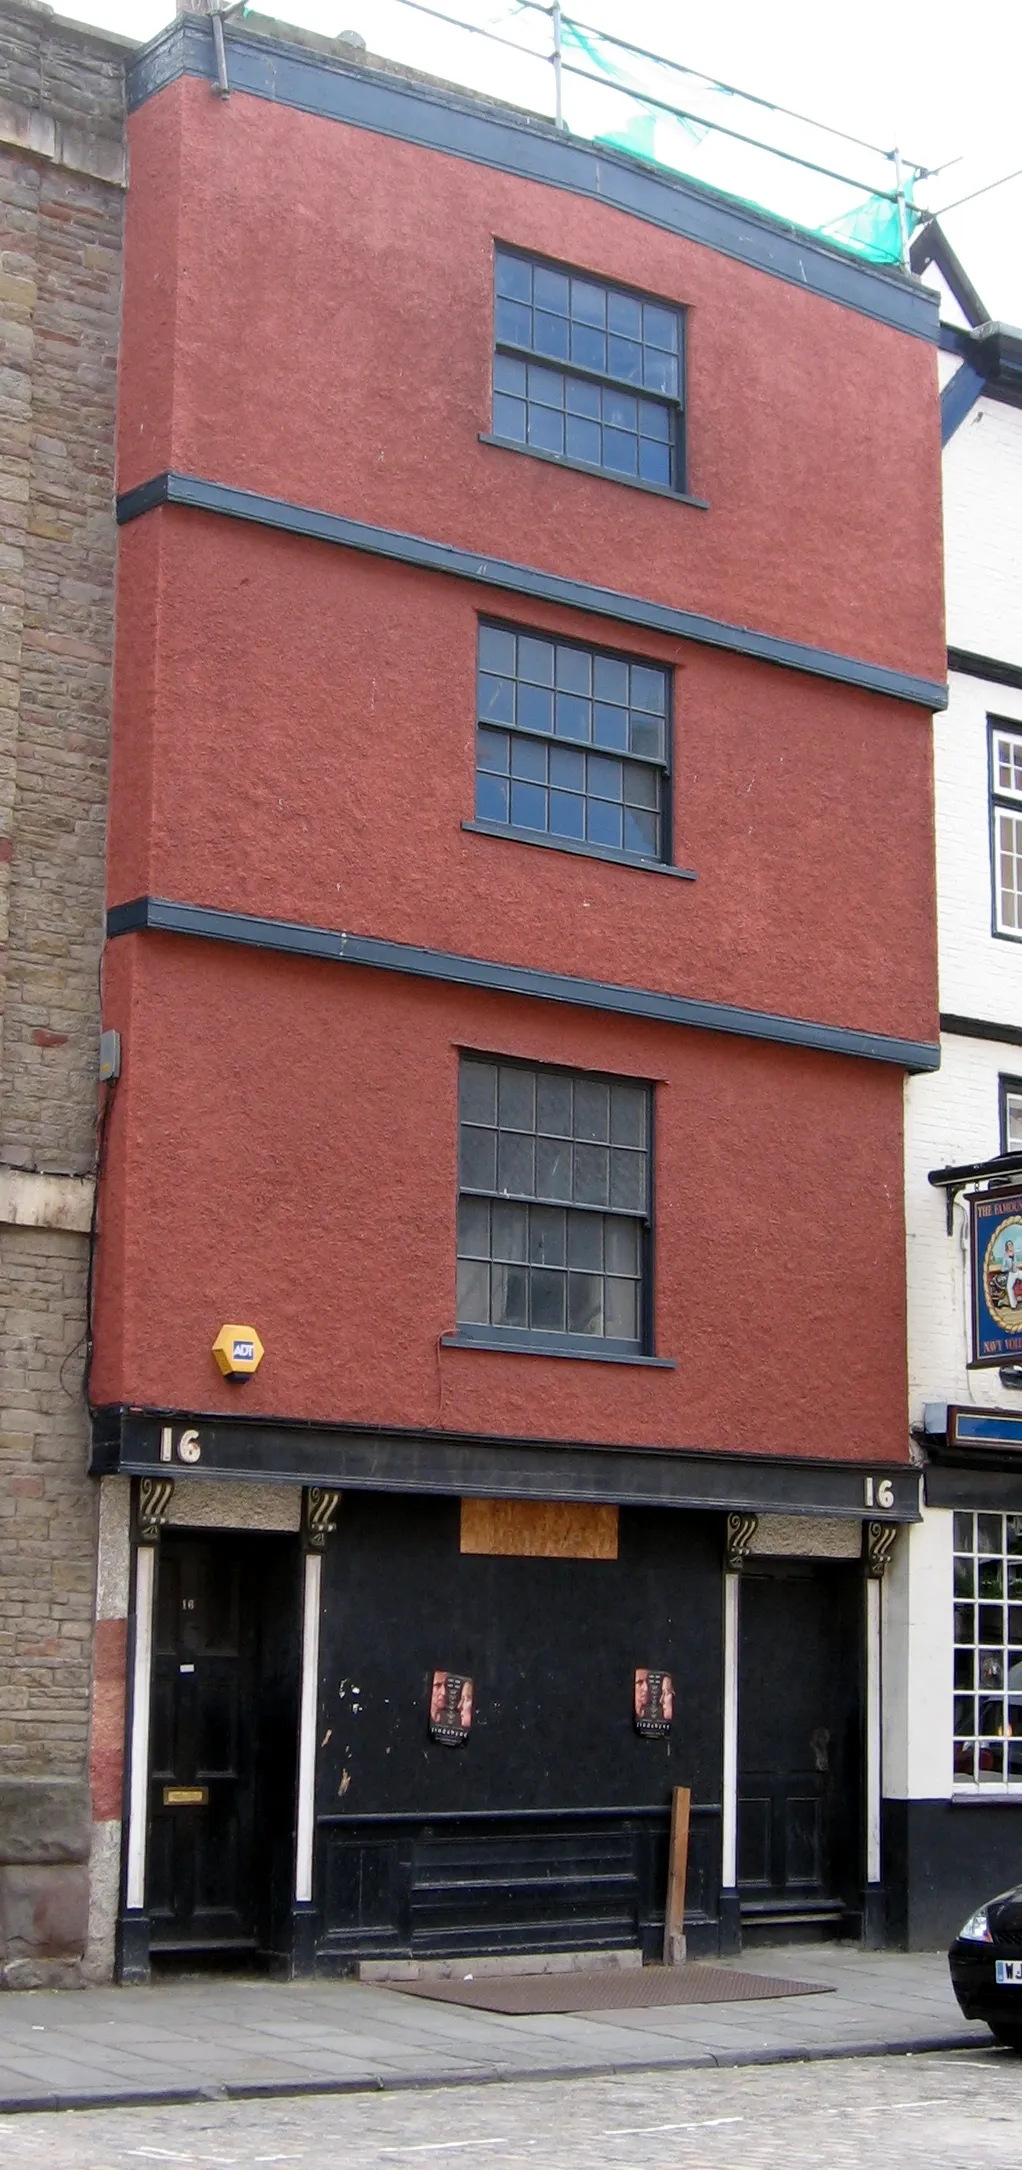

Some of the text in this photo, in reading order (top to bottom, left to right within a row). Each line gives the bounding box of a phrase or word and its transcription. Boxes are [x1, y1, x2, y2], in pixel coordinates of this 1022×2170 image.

[977, 1204, 992, 1218] THE
[233, 1343, 254, 1357] ADT
[983, 1340, 1002, 1353] NAVY
[160, 1427, 201, 1464] 16
[864, 1477, 895, 1509] 16
[182, 1599, 195, 1611] 16
